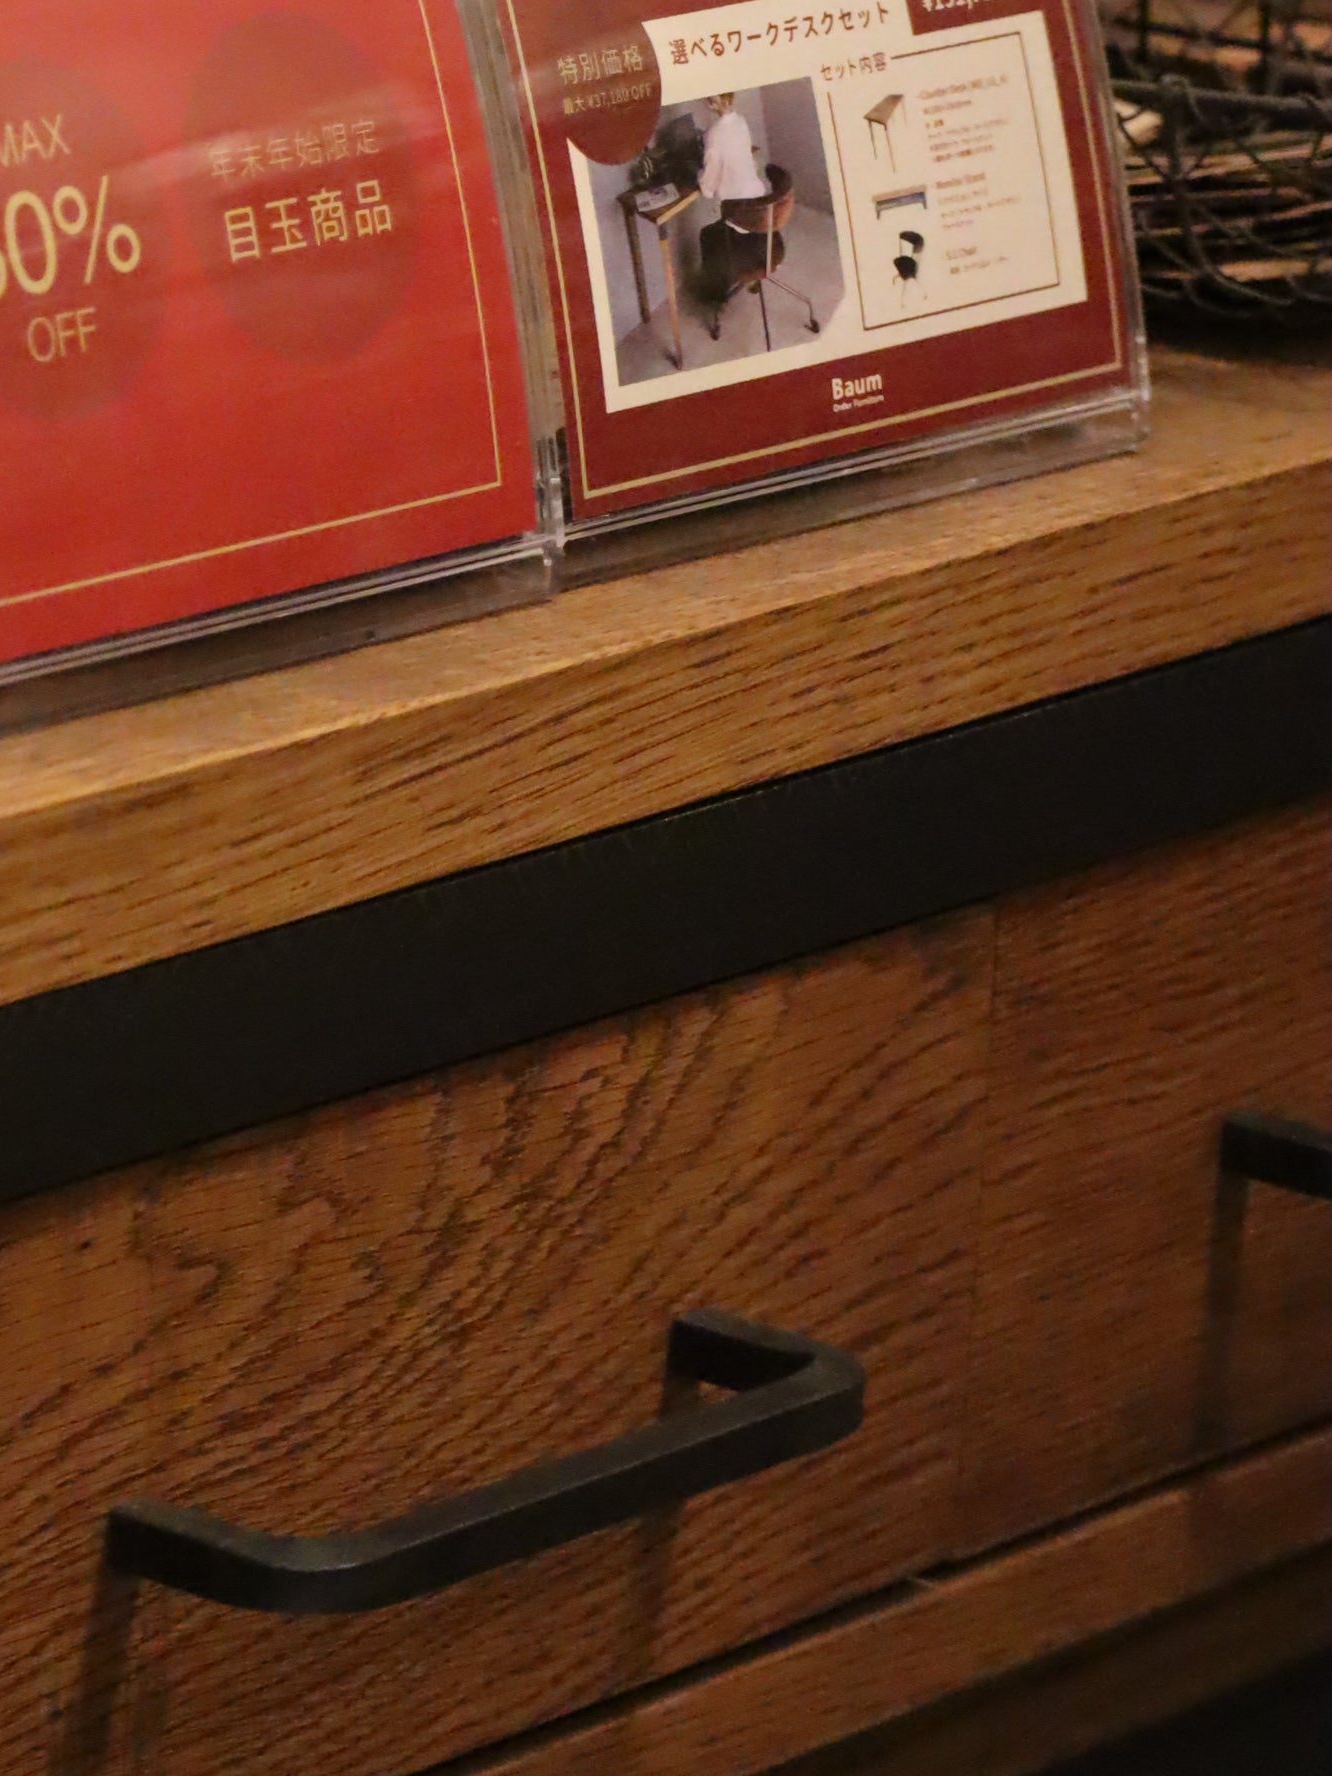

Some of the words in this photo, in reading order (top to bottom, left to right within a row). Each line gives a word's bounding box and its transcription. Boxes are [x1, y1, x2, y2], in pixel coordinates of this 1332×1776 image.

[668, 0, 890, 66] 選べるワークデスクセット
[557, 45, 643, 85] 特別価格
[820, 51, 888, 82] セット内容
[629, 83, 653, 101] OFF
[209, 120, 380, 182] 年末年始限定
[224, 179, 393, 263] 目玉商品
[26, 306, 98, 363] OFF
[831, 374, 883, 400] Baum
